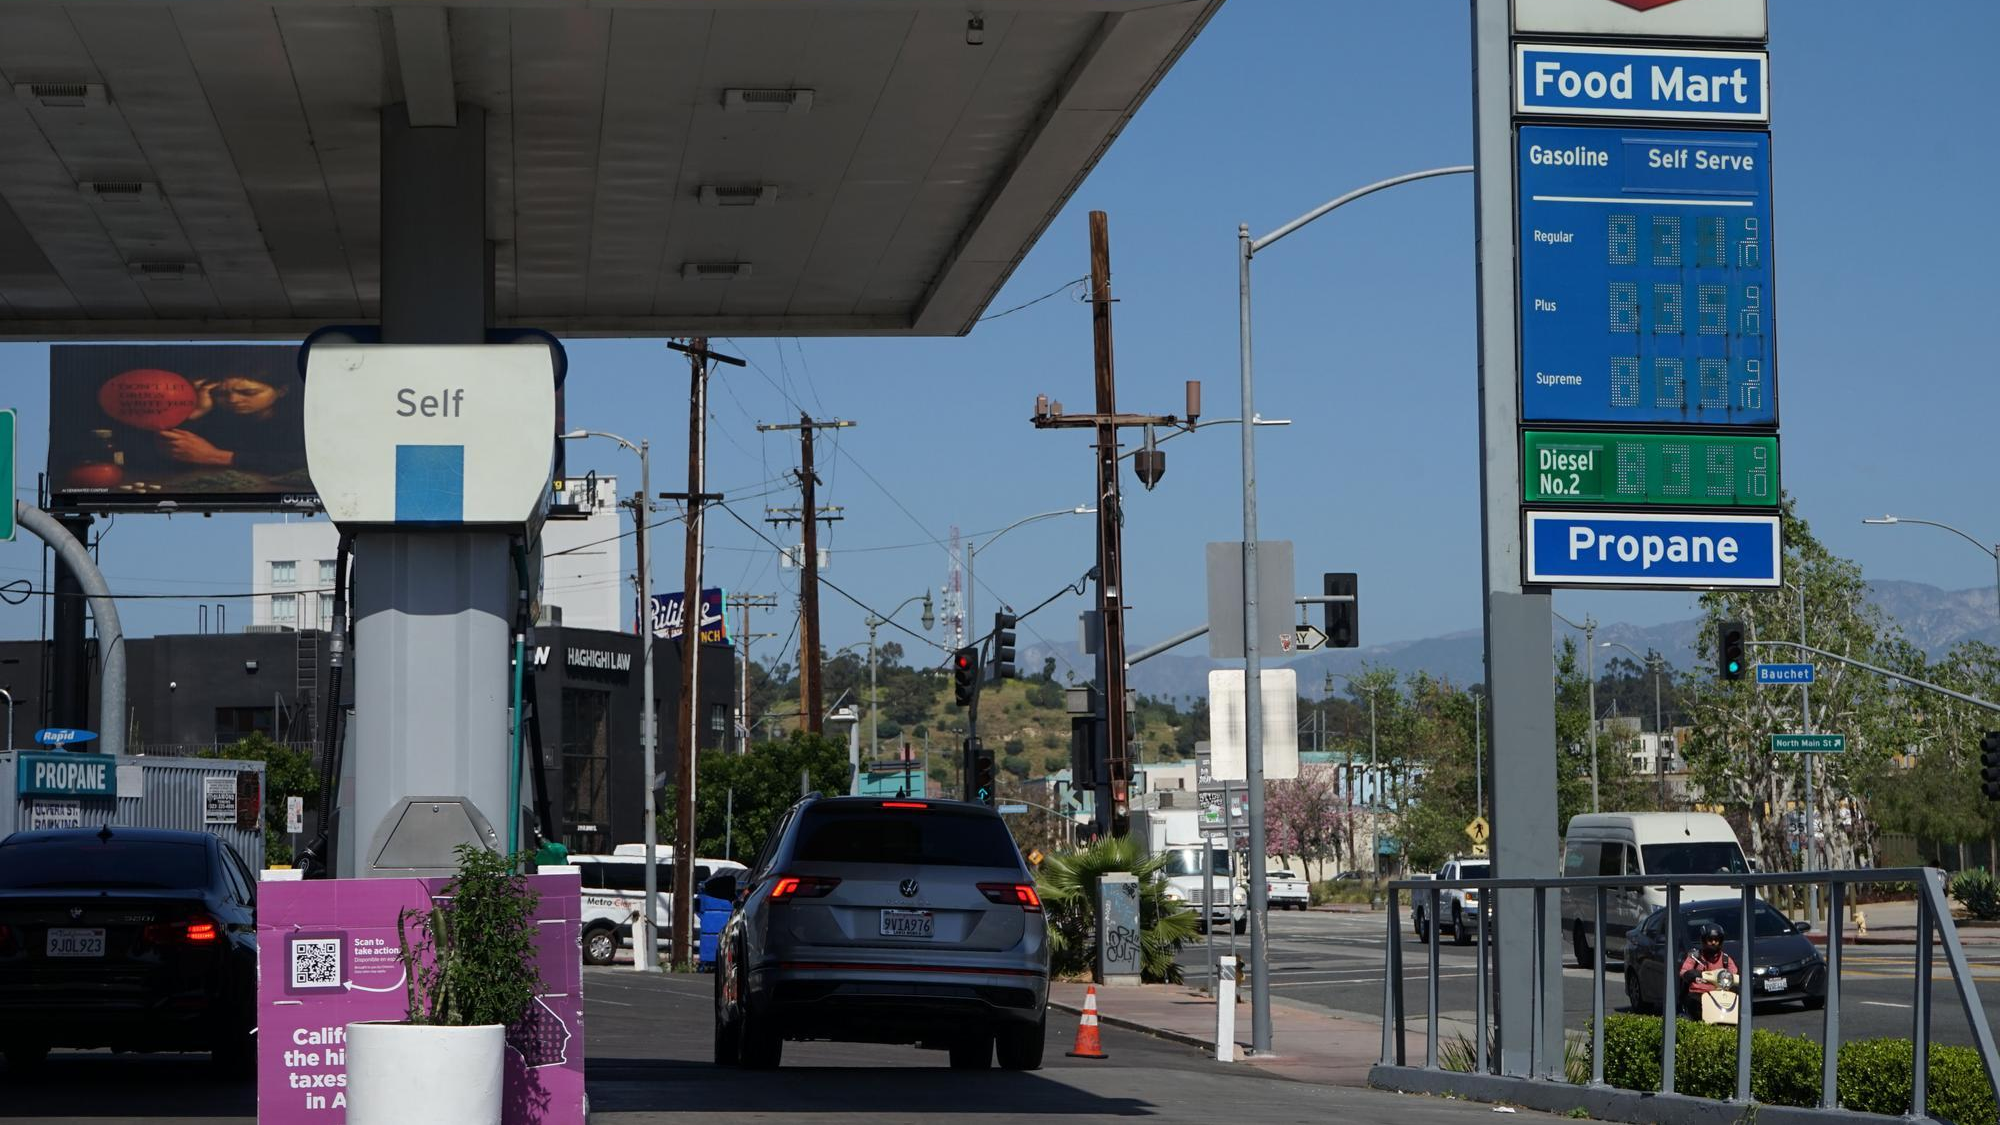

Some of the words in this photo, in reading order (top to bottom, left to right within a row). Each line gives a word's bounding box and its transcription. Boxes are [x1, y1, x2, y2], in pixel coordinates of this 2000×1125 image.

[1535, 61, 1633, 100] Food
[1651, 65, 1748, 104] Mart
[1529, 145, 1609, 167] Gasoline
[1648, 148, 1688, 169] Self
[1695, 150, 1754, 171] Serve
[1534, 230, 1574, 245] Regular
[1535, 299, 1557, 312] Plus
[1536, 372, 1582, 387] Supreme
[396, 388, 465, 418] Self
[1540, 449, 1593, 471] Diesel
[1540, 474, 1580, 495] No.2
[1569, 526, 1739, 570] Propane
[567, 647, 611, 669] HAGHIGHI
[611, 653, 631, 672] LAW
[1760, 668, 1810, 680] Bauchet
[43, 729, 75, 743] Rapid
[1776, 738, 1799, 748] North
[1801, 738, 1821, 748] Main
[1822, 738, 1832, 748] St
[35, 762, 106, 791] PROPANE
[35, 802, 65, 816] OLVERA
[34, 818, 79, 830] PARKING
[587, 896, 613, 907] Metro
[883, 917, 931, 933] 9VIA976
[354, 938, 374, 946] Scan
[375, 938, 385, 946] to
[354, 946, 373, 955] take
[284, 1049, 321, 1067] the
[325, 1048, 347, 1067] hi
[289, 1073, 347, 1088] taxes
[306, 1092, 325, 1109] in
